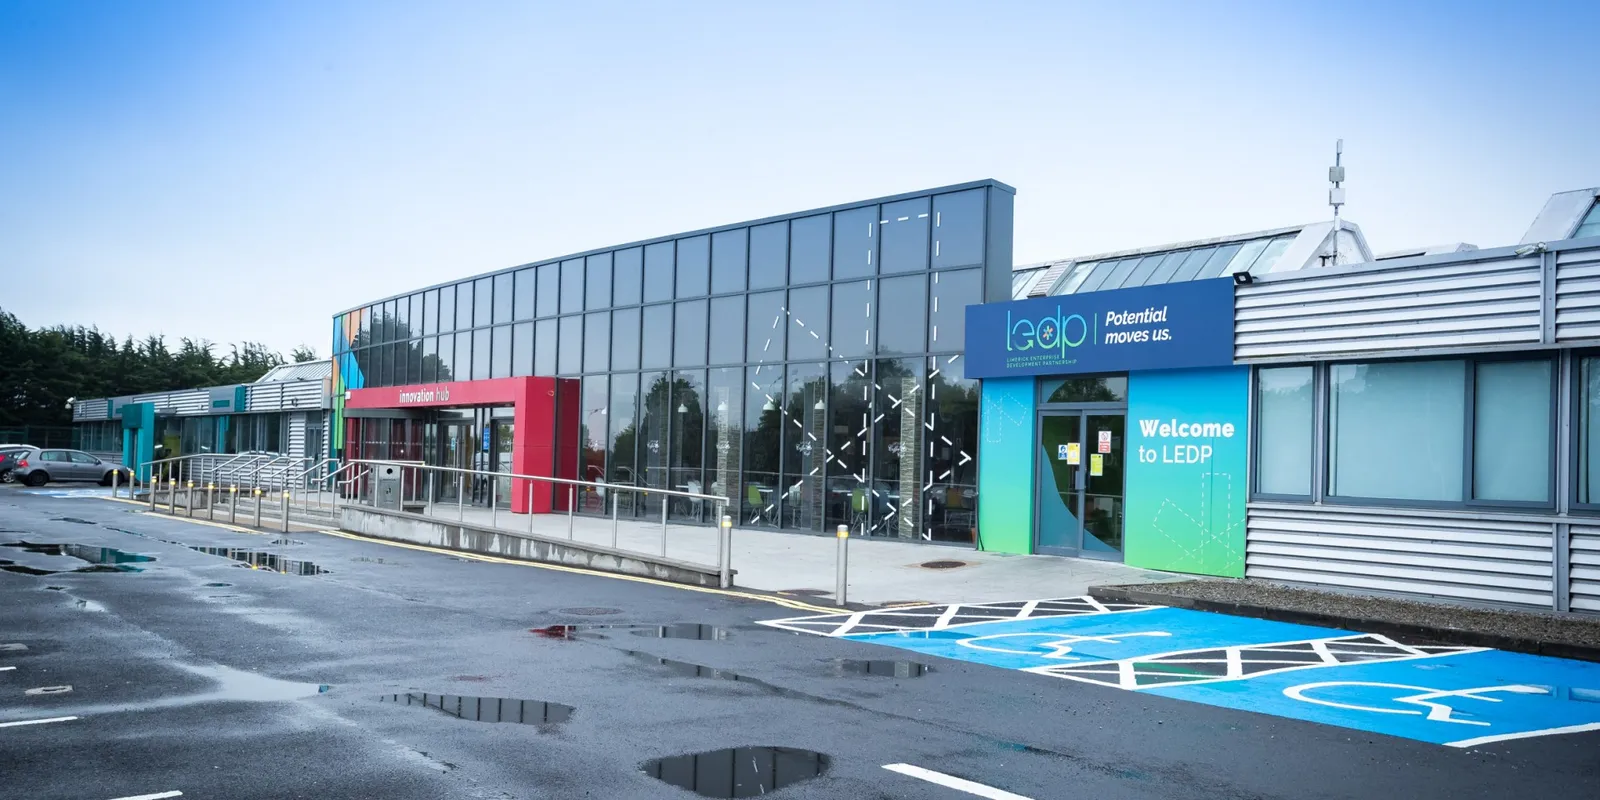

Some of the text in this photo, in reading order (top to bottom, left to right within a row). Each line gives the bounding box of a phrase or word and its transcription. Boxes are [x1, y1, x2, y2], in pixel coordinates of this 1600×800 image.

[1105, 306, 1168, 327] Potential
[1104, 328, 1172, 345] moves us.
[1006, 361, 1041, 369] DEVELOPMENT
[1030, 354, 1060, 362] ENTERPRISE
[399, 386, 450, 403] innovation hub
[1138, 418, 1235, 438] Welcome
[1138, 445, 1213, 464] to LEDP
